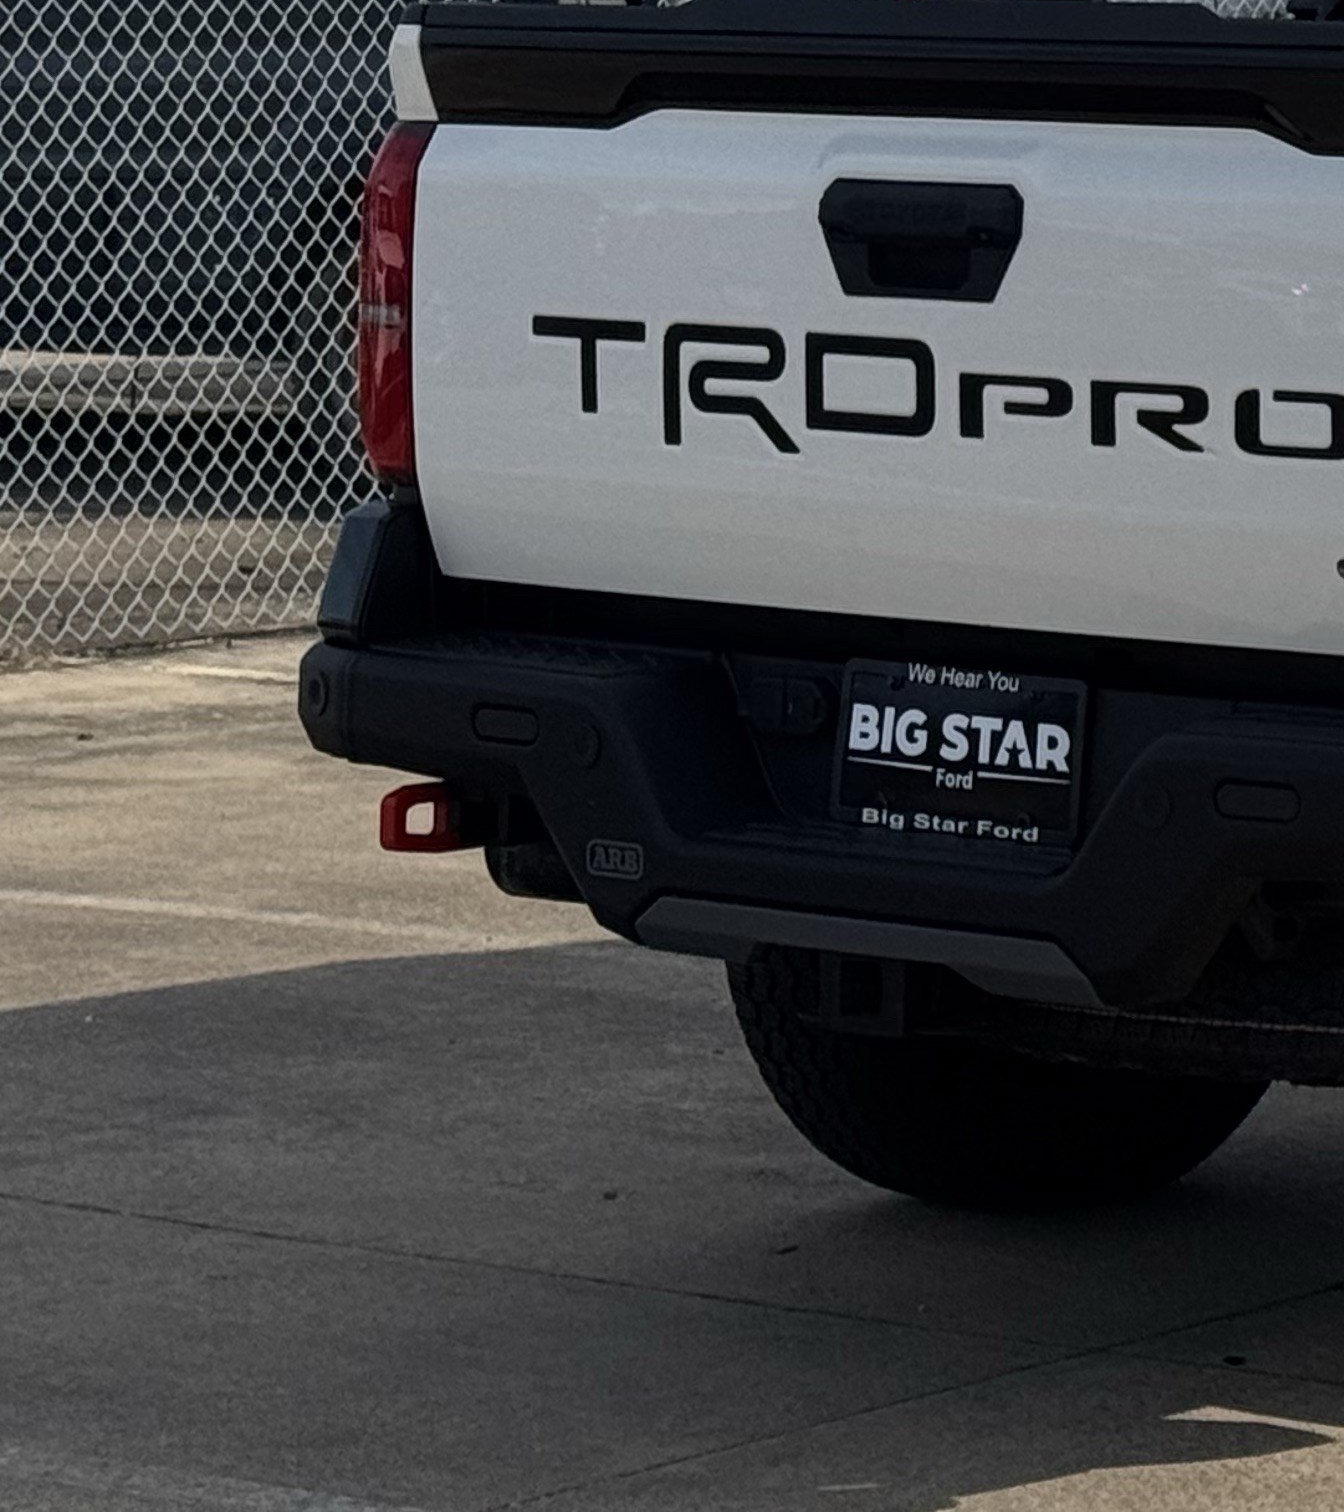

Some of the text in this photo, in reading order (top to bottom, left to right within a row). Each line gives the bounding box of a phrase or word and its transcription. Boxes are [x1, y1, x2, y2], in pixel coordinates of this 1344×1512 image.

[532, 314, 937, 455] TRD
[907, 661, 1020, 693] We Hear You
[848, 702, 1072, 774] BIG STAR
[934, 767, 974, 791] Ford
[861, 806, 1040, 843] Big Star Ford
[591, 844, 640, 875] ARB
